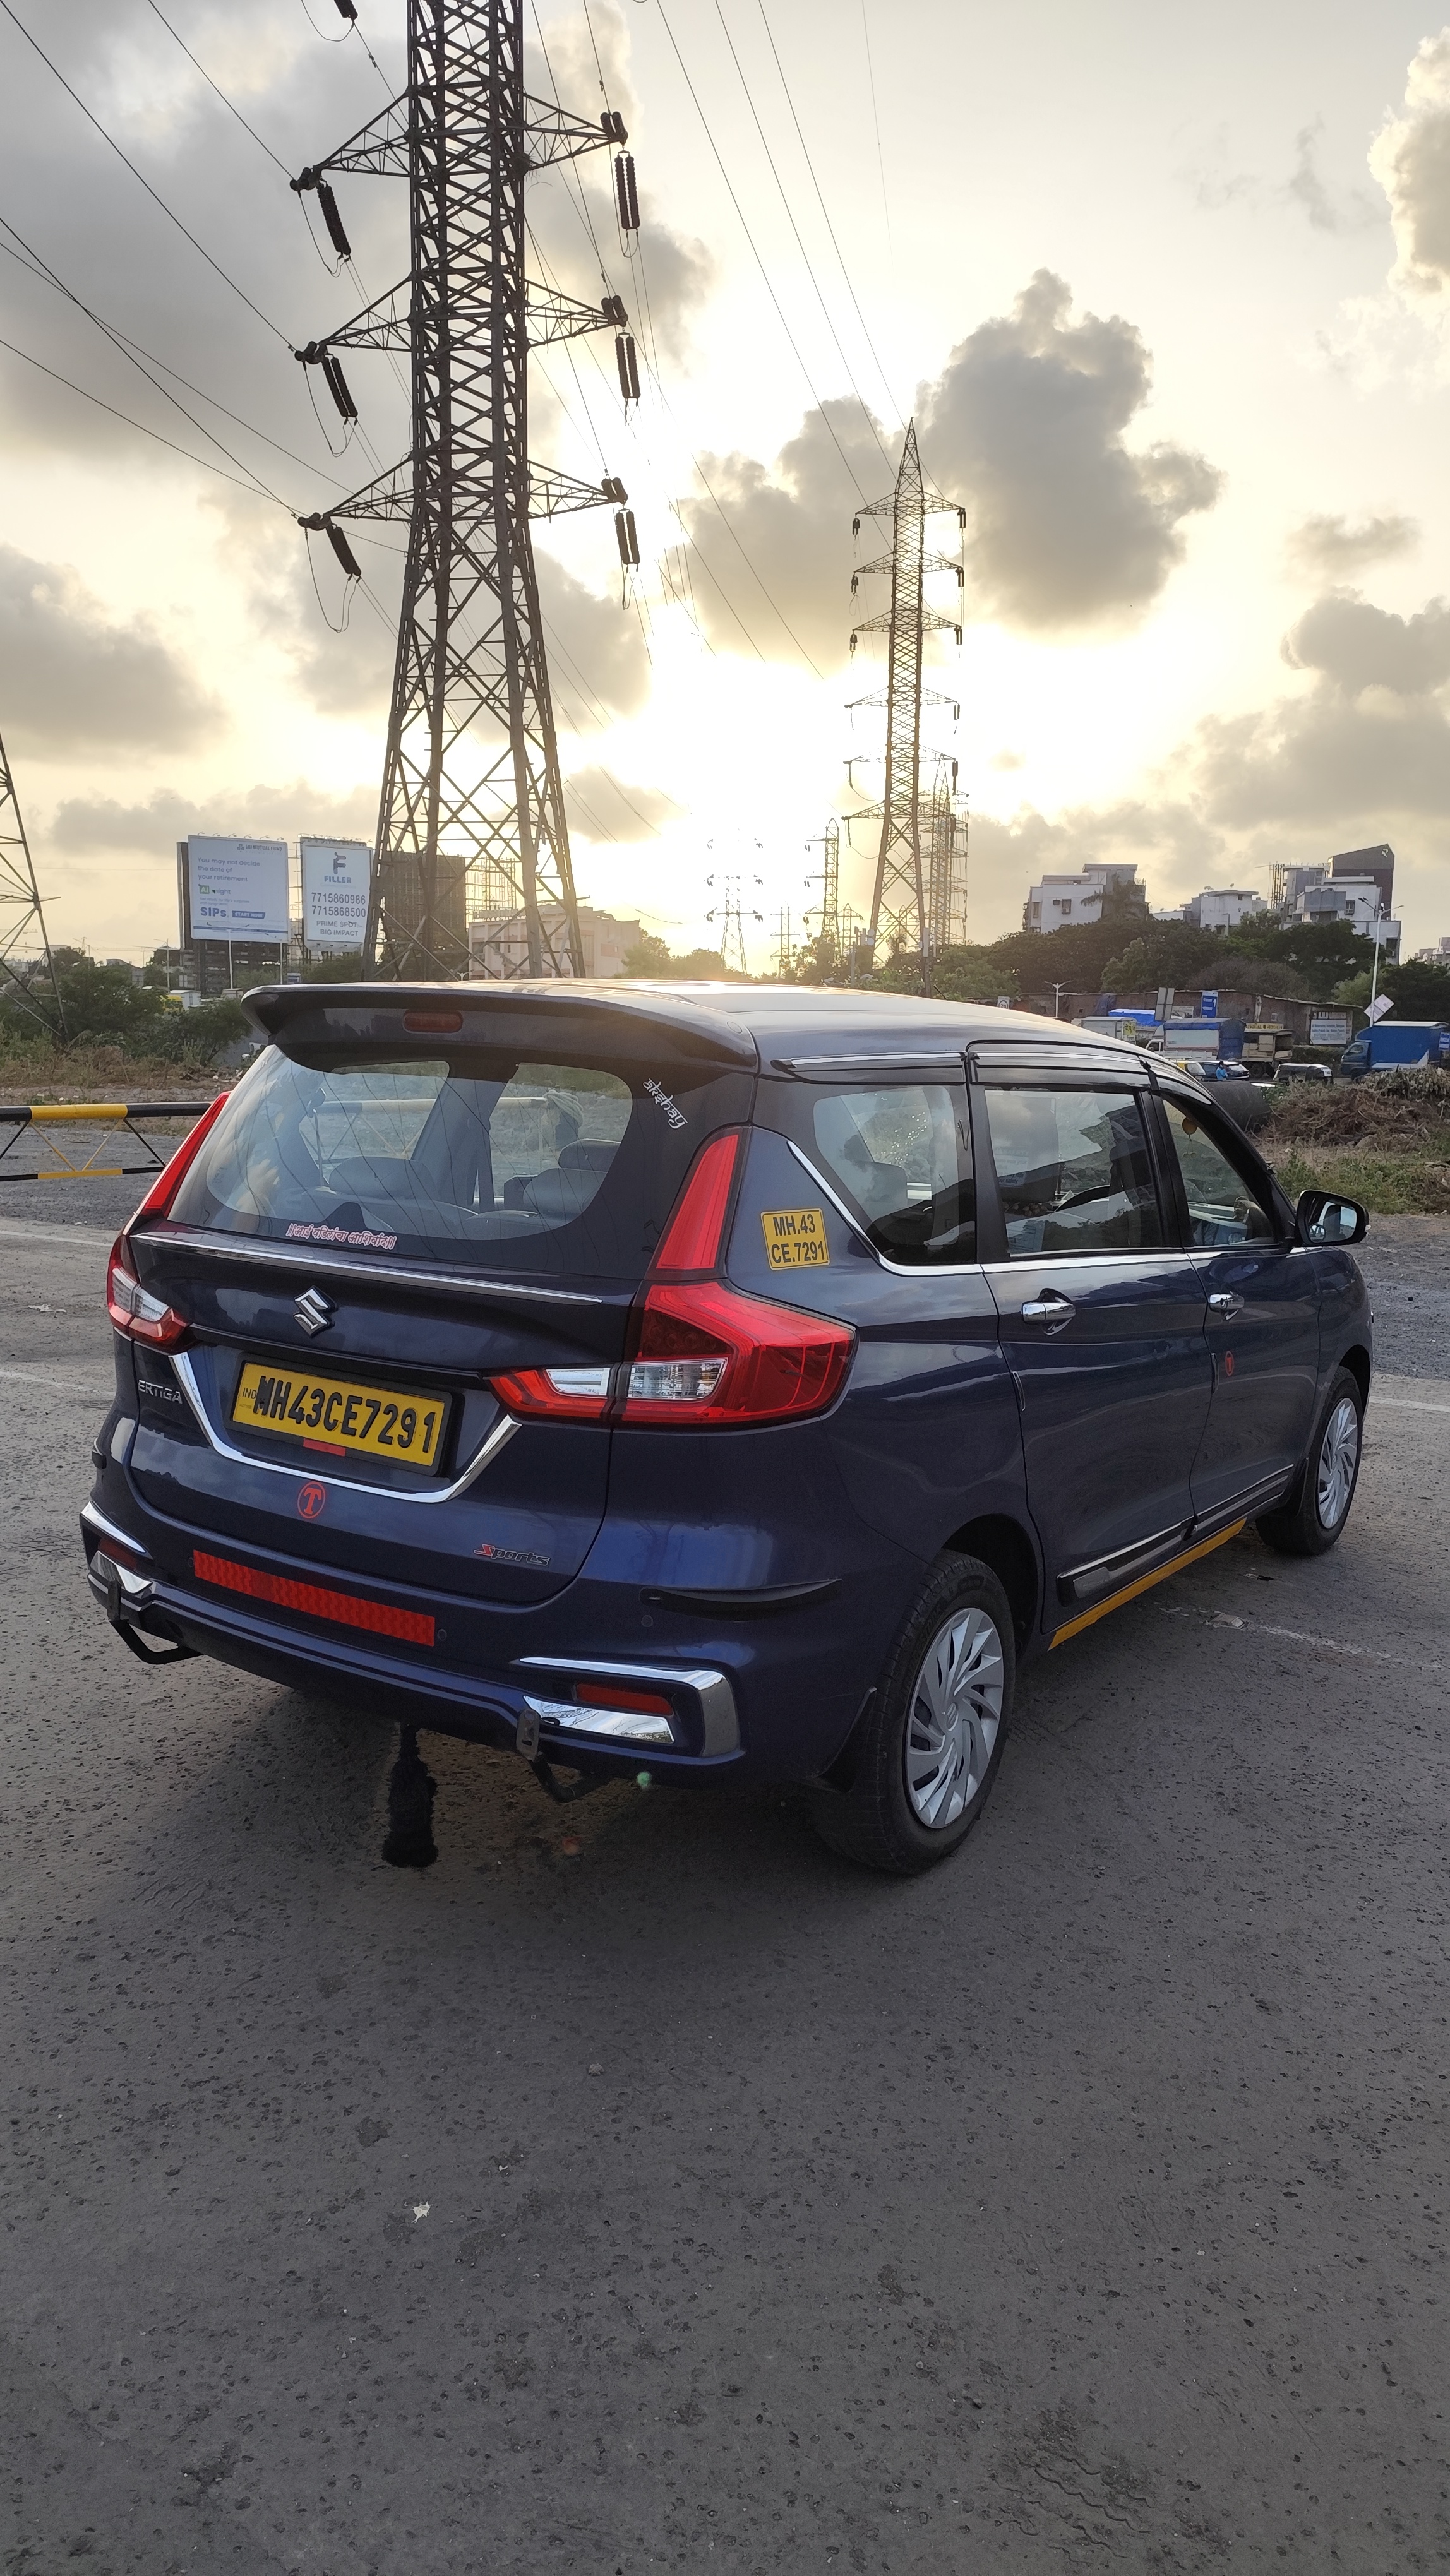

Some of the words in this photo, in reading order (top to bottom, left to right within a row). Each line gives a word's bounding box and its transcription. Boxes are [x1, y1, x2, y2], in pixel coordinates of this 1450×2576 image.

[323, 875, 352, 884] FILLER
[311, 892, 366, 905] 7715860986
[311, 905, 366, 918] 7715868500
[642, 1078, 688, 1129] akshay
[772, 1213, 816, 1237] MH.43
[770, 1240, 825, 1263] CE.7291
[138, 1380, 183, 1404] ERTIGA
[242, 1387, 257, 1400] IND
[253, 1374, 437, 1454] MH43CE7291
[473, 1544, 551, 1566] Sports
